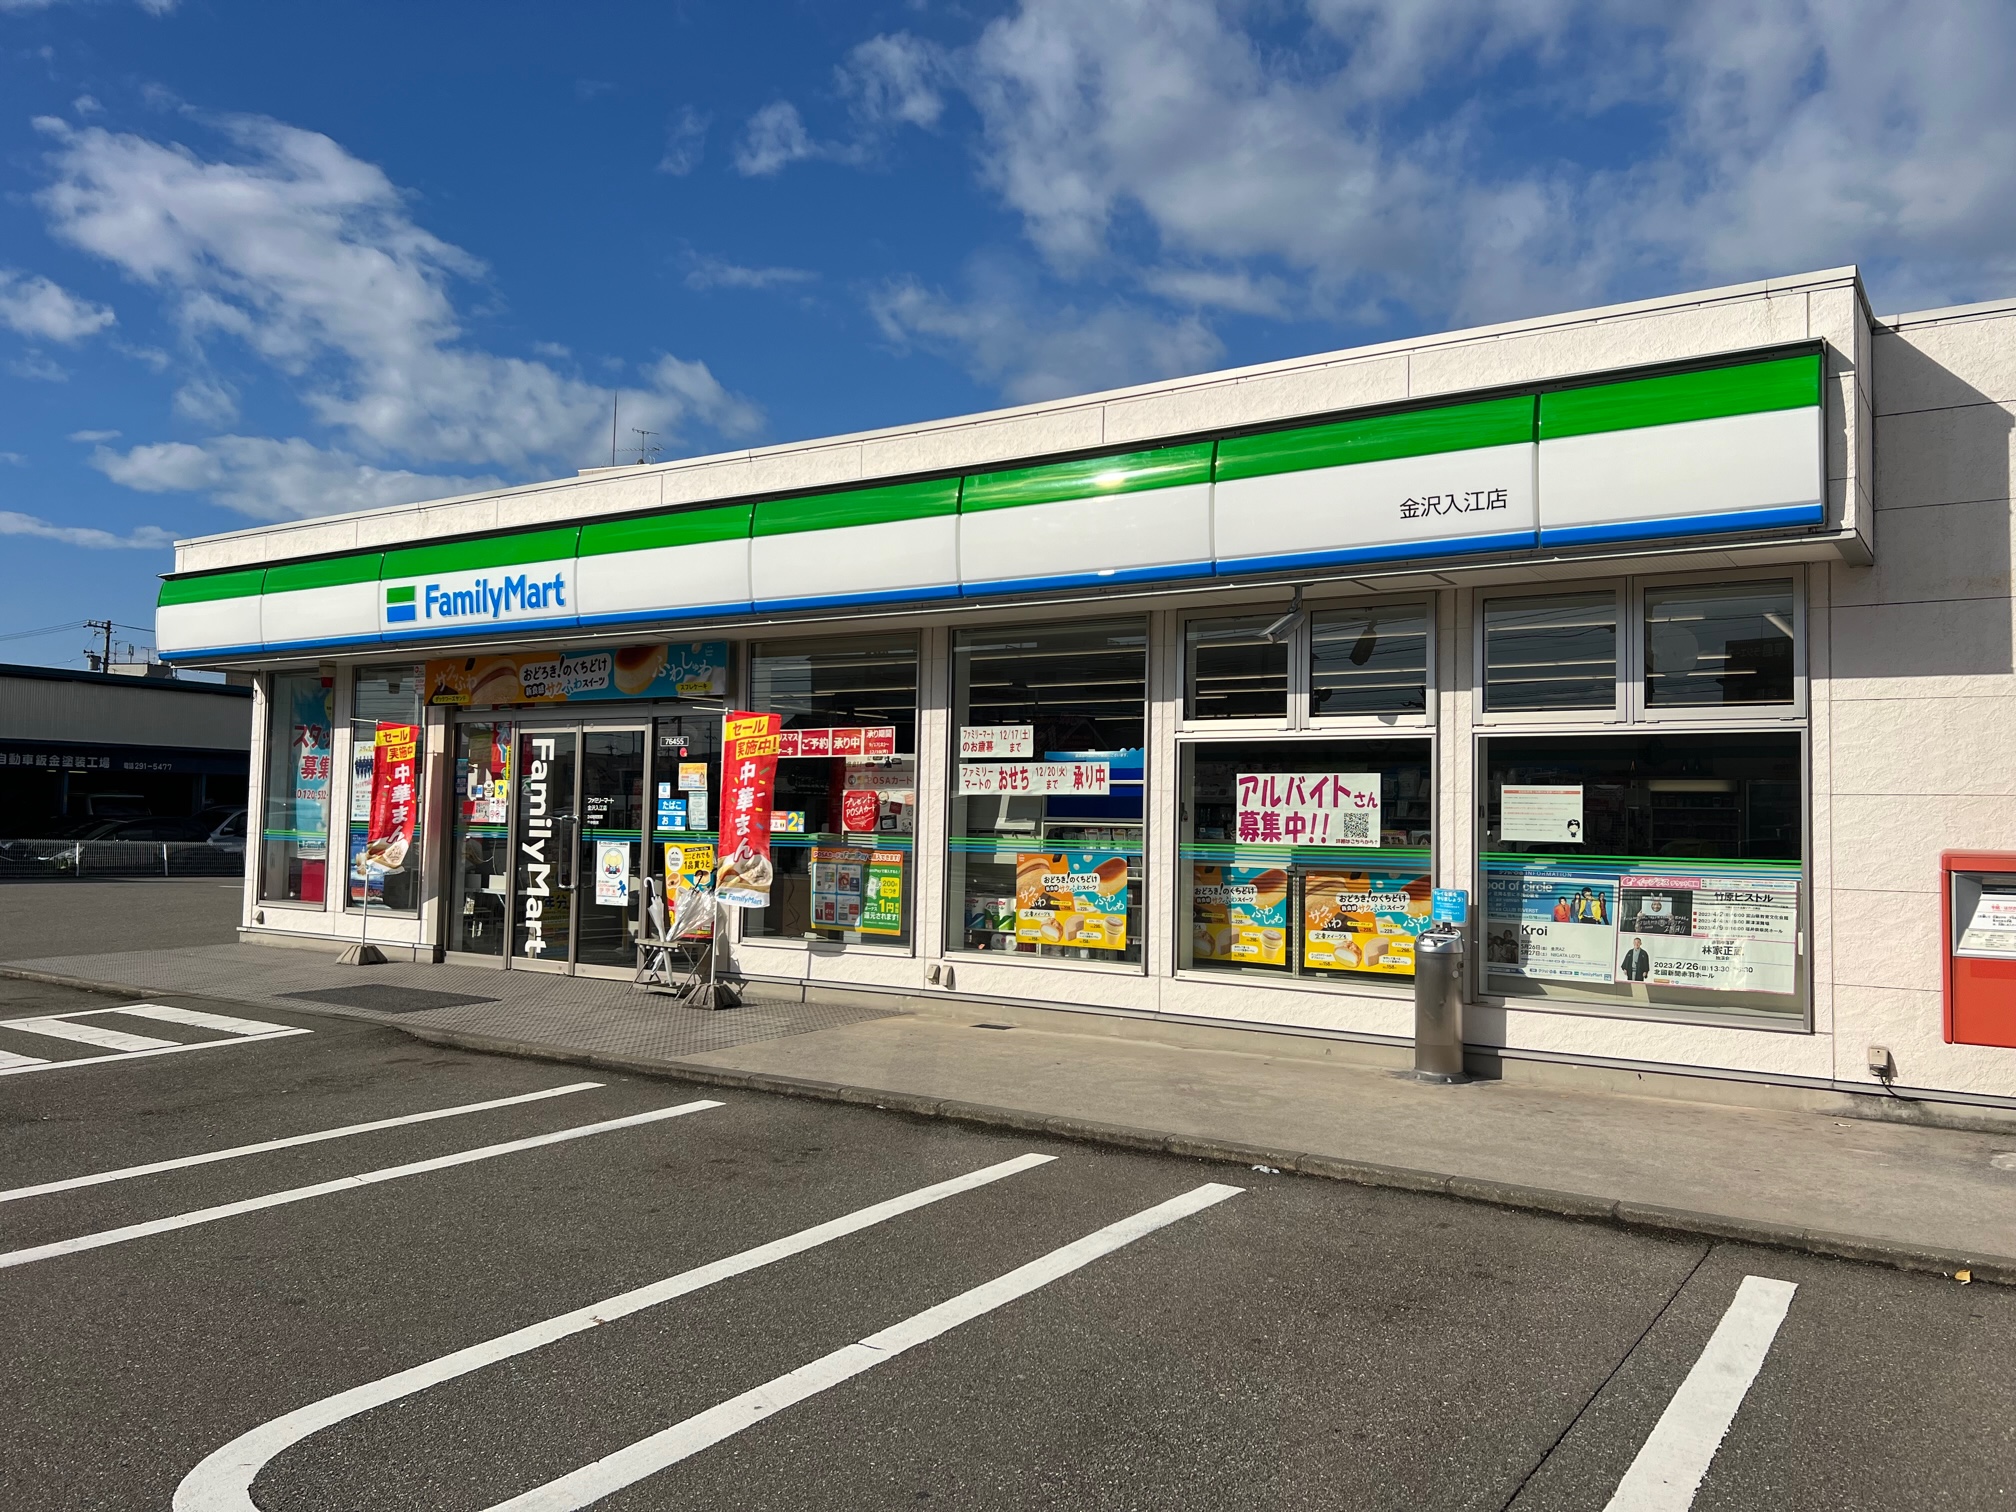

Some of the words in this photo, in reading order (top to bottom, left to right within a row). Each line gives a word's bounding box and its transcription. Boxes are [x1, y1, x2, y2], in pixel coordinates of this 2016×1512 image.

[1400, 488, 1507, 519] 金沢入江店
[426, 572, 566, 619] FamilyMart
[733, 719, 765, 736] セール
[383, 730, 408, 743] セール
[963, 729, 994, 739] ファミリーマート
[999, 729, 1031, 740] 12/17(土)
[737, 737, 777, 757] 実施中!
[802, 737, 829, 750] ご予約
[833, 736, 860, 749] 承り中
[963, 741, 993, 752] のお歳暮
[1009, 743, 1021, 752] まで
[962, 766, 993, 777] ファミリー
[1035, 766, 1068, 777] 12/20(火)
[1073, 764, 1105, 791] 承り中
[964, 779, 991, 790] マートの
[999, 766, 1029, 791] おせち
[1046, 780, 1058, 789] まで
[1239, 775, 1378, 809] アルバイトさん
[387, 763, 411, 842] 中華まん
[662, 800, 682, 810] たばこ
[734, 761, 756, 862] 中華まん
[1239, 811, 1330, 844] 募集中!!
[522, 738, 555, 953] FamilyMart
[1043, 872, 1098, 884] おどろき!のくちどけ
[1194, 882, 1255, 895] おどろき!のくちどけ
[1522, 881, 1553, 893] circle
[727, 893, 763, 905] FamilyMart
[1338, 890, 1406, 903] おどろき!のくちどけ
[1714, 892, 1774, 903] 竹原ピストル
[1521, 925, 1548, 936] Kroi
